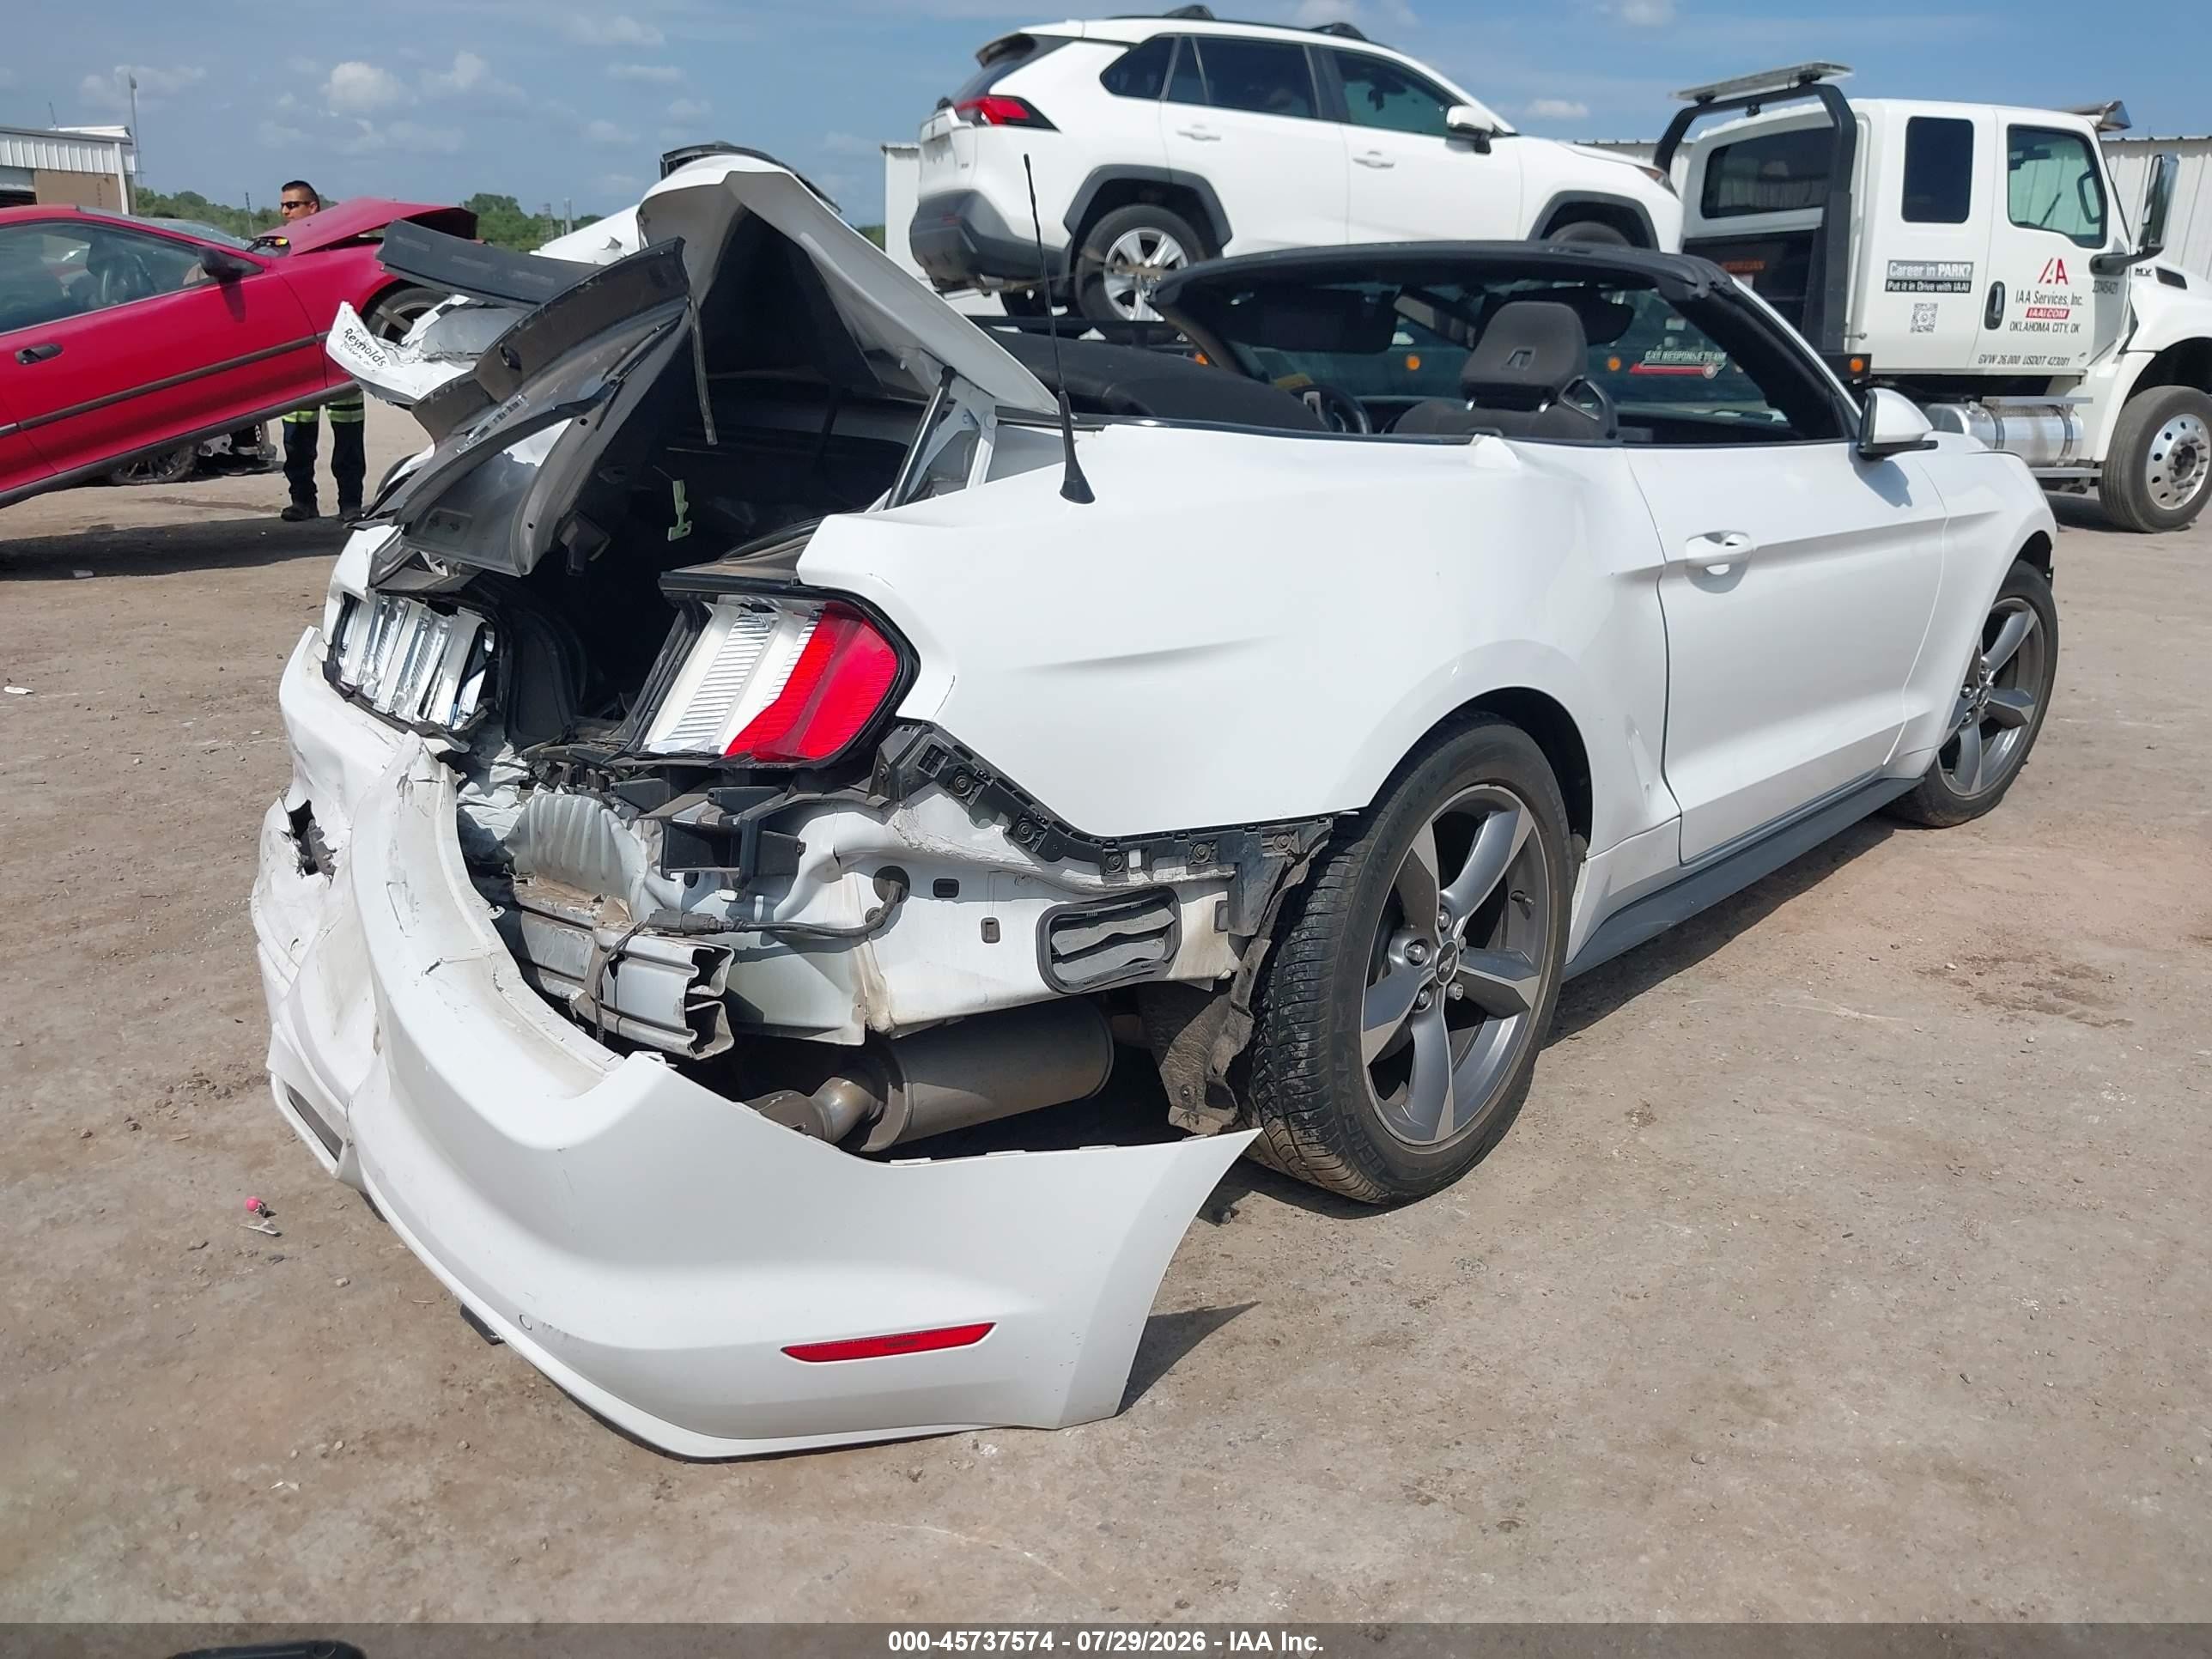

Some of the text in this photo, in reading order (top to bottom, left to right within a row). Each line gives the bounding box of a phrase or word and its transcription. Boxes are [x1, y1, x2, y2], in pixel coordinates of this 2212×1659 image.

[1889, 261, 1971, 278] Career in PARK?
[1887, 280, 1900, 290] Put
[1908, 281, 1916, 290] in
[1917, 281, 1935, 291] Drive
[1936, 282, 1951, 291] with
[2015, 290, 2031, 303] IAA
[2070, 292, 2082, 305] Inc.
[2009, 321, 2050, 332] OKLAHOMA
[2070, 323, 2081, 333] OK
[344, 328, 386, 367] Reynolds
[1978, 354, 1997, 364] GVW
